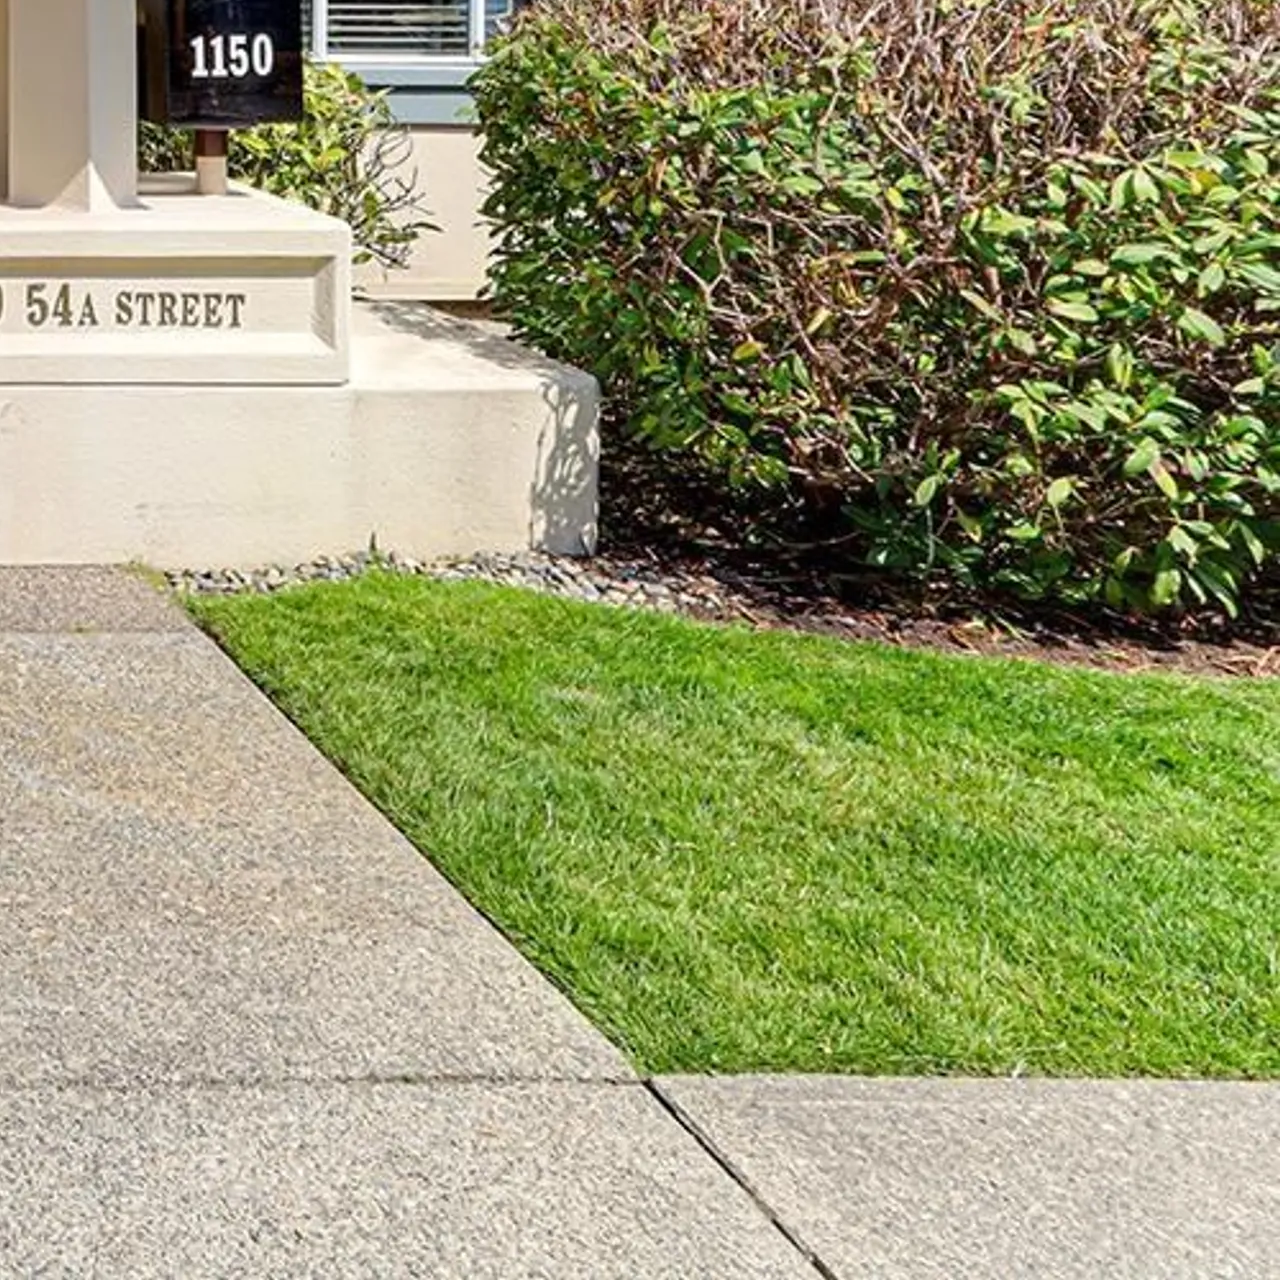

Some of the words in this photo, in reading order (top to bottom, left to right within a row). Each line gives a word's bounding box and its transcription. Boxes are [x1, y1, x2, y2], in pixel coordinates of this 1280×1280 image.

[190, 33, 274, 77] 1150
[25, 283, 100, 328] 54A
[115, 291, 246, 328] STREET
